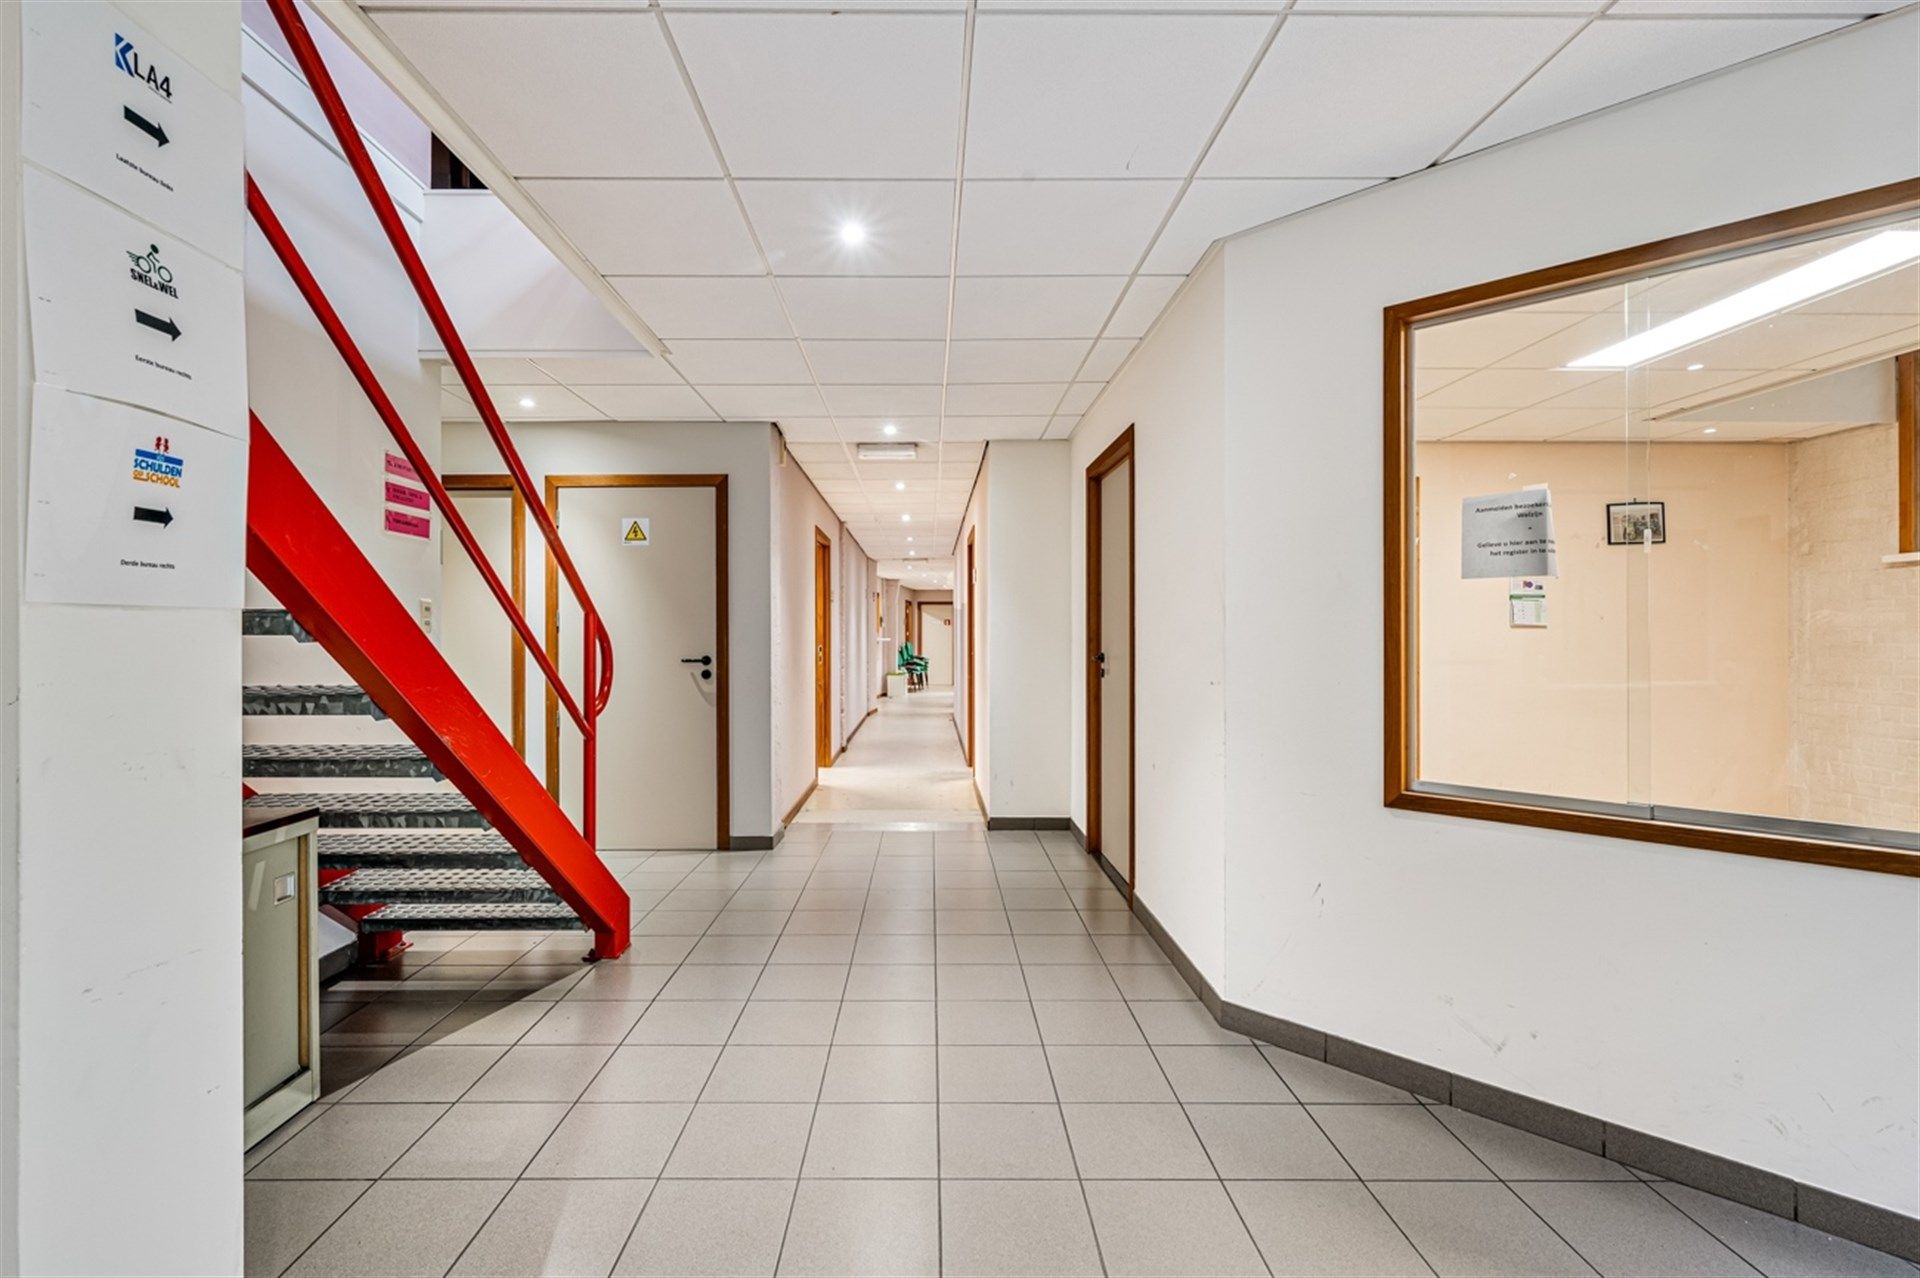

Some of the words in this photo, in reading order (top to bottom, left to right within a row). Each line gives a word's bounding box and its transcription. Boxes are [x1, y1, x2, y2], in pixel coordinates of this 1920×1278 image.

[114, 32, 173, 99] KLA4
[155, 361, 175, 373] bureau
[133, 457, 183, 478] SCHULDEN
[144, 472, 181, 488] SCHOOL
[1475, 505, 1513, 514] Aanmelden
[120, 559, 139, 567] Derde
